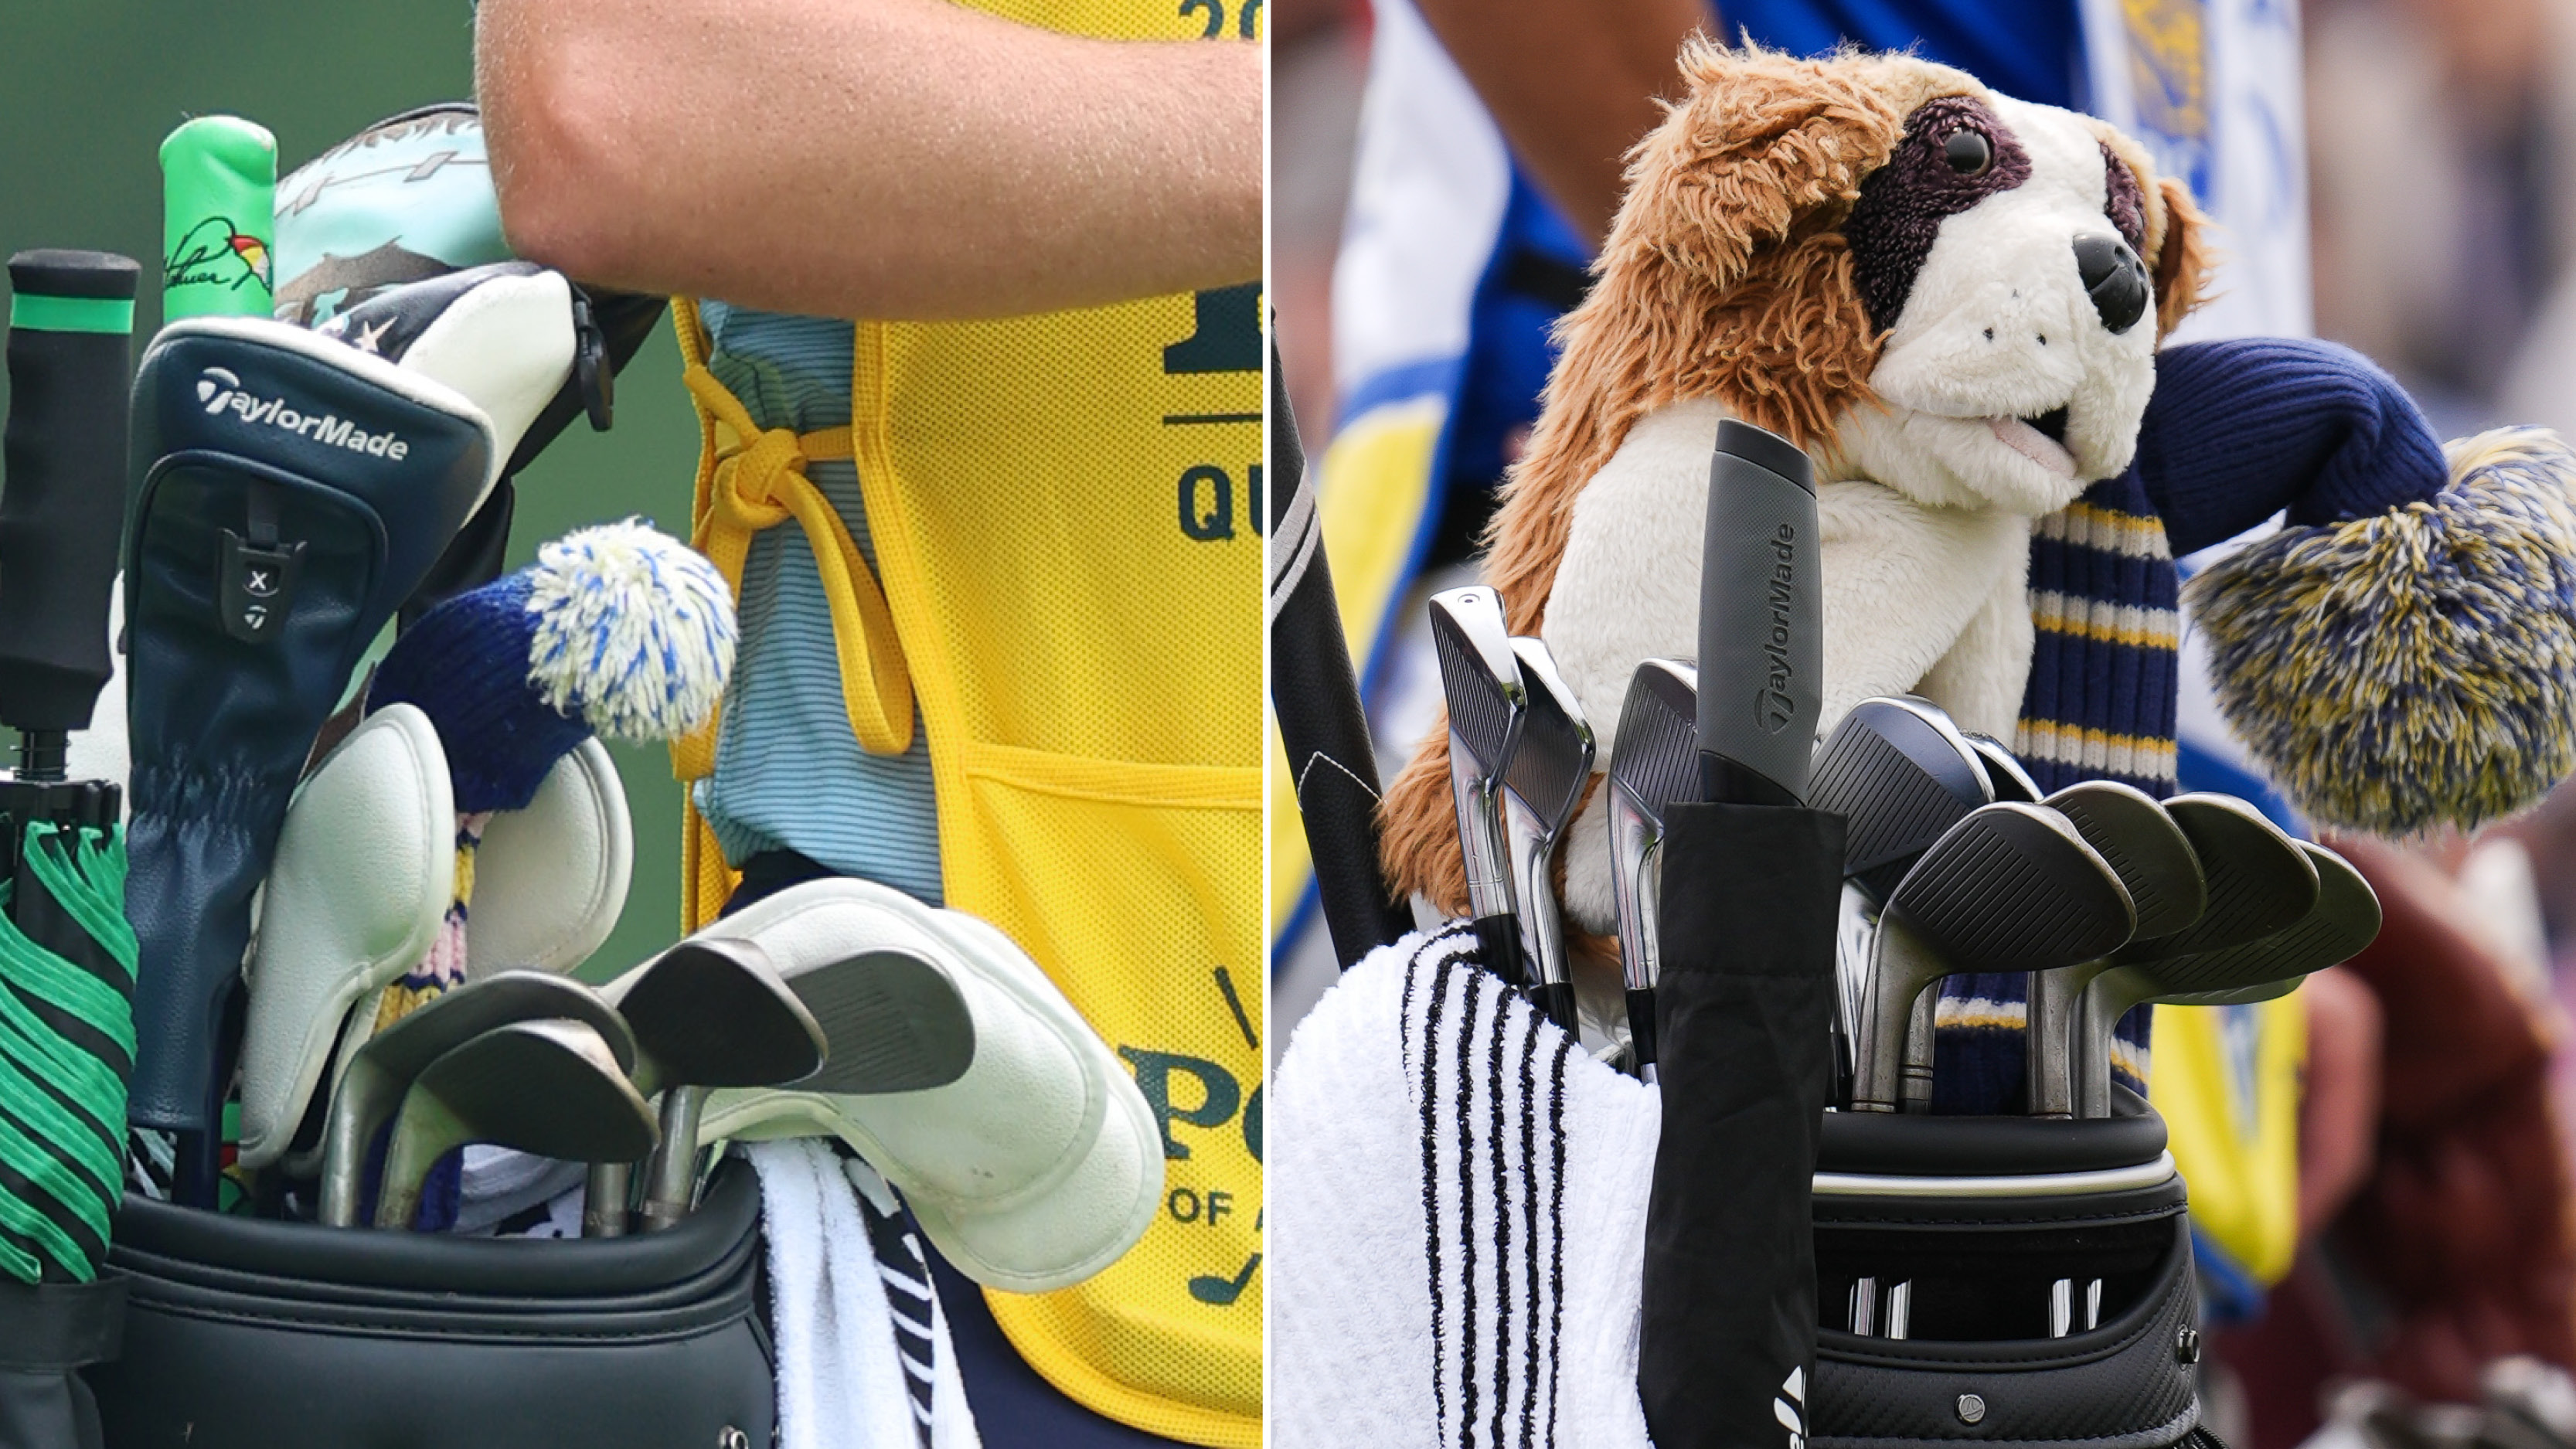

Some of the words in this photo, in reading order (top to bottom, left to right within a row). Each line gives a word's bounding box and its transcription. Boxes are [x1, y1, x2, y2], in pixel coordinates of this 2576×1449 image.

[197, 366, 408, 461] TaylorMade
[1754, 523, 1795, 733] TaylorMade
[1118, 1044, 1263, 1165] P
[1168, 1188, 1233, 1227] OF
